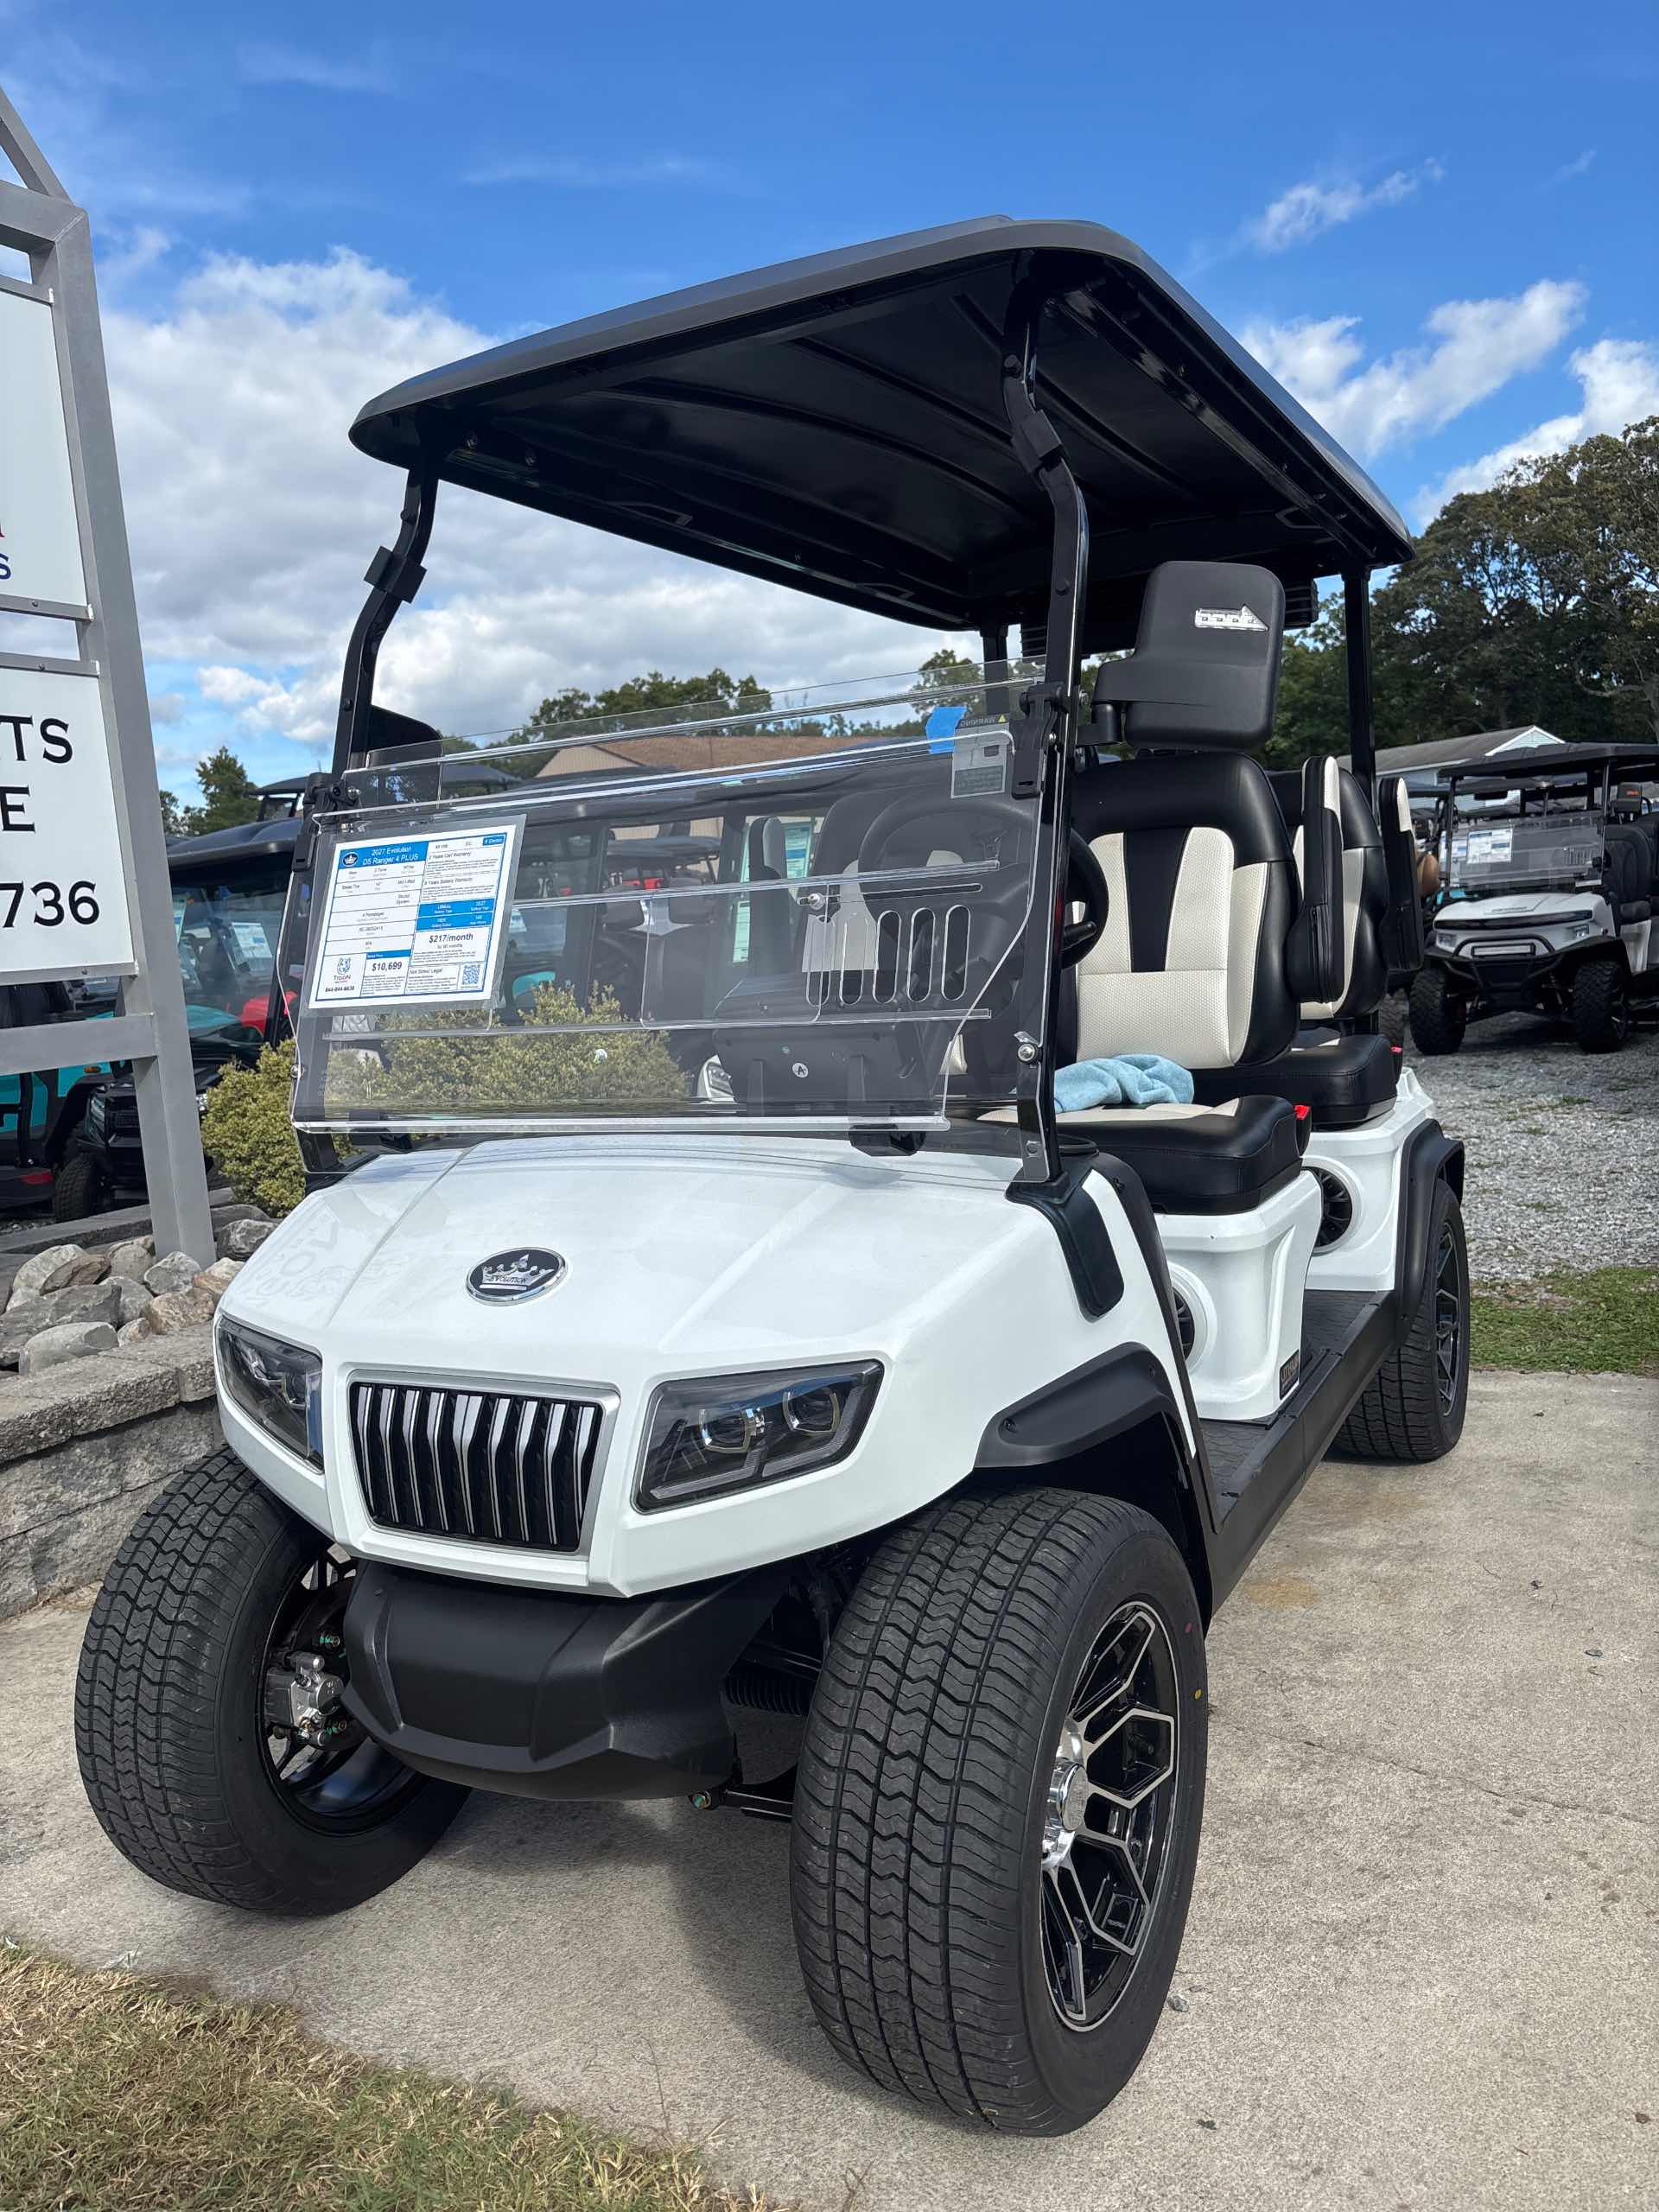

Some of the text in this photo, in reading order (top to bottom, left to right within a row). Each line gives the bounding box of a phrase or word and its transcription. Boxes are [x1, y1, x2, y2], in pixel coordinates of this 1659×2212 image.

[372, 856, 395, 865] Ranger
[400, 853, 419, 861] PLUS
[429, 933, 474, 944] $217/month
[372, 961, 403, 972] $10,699
